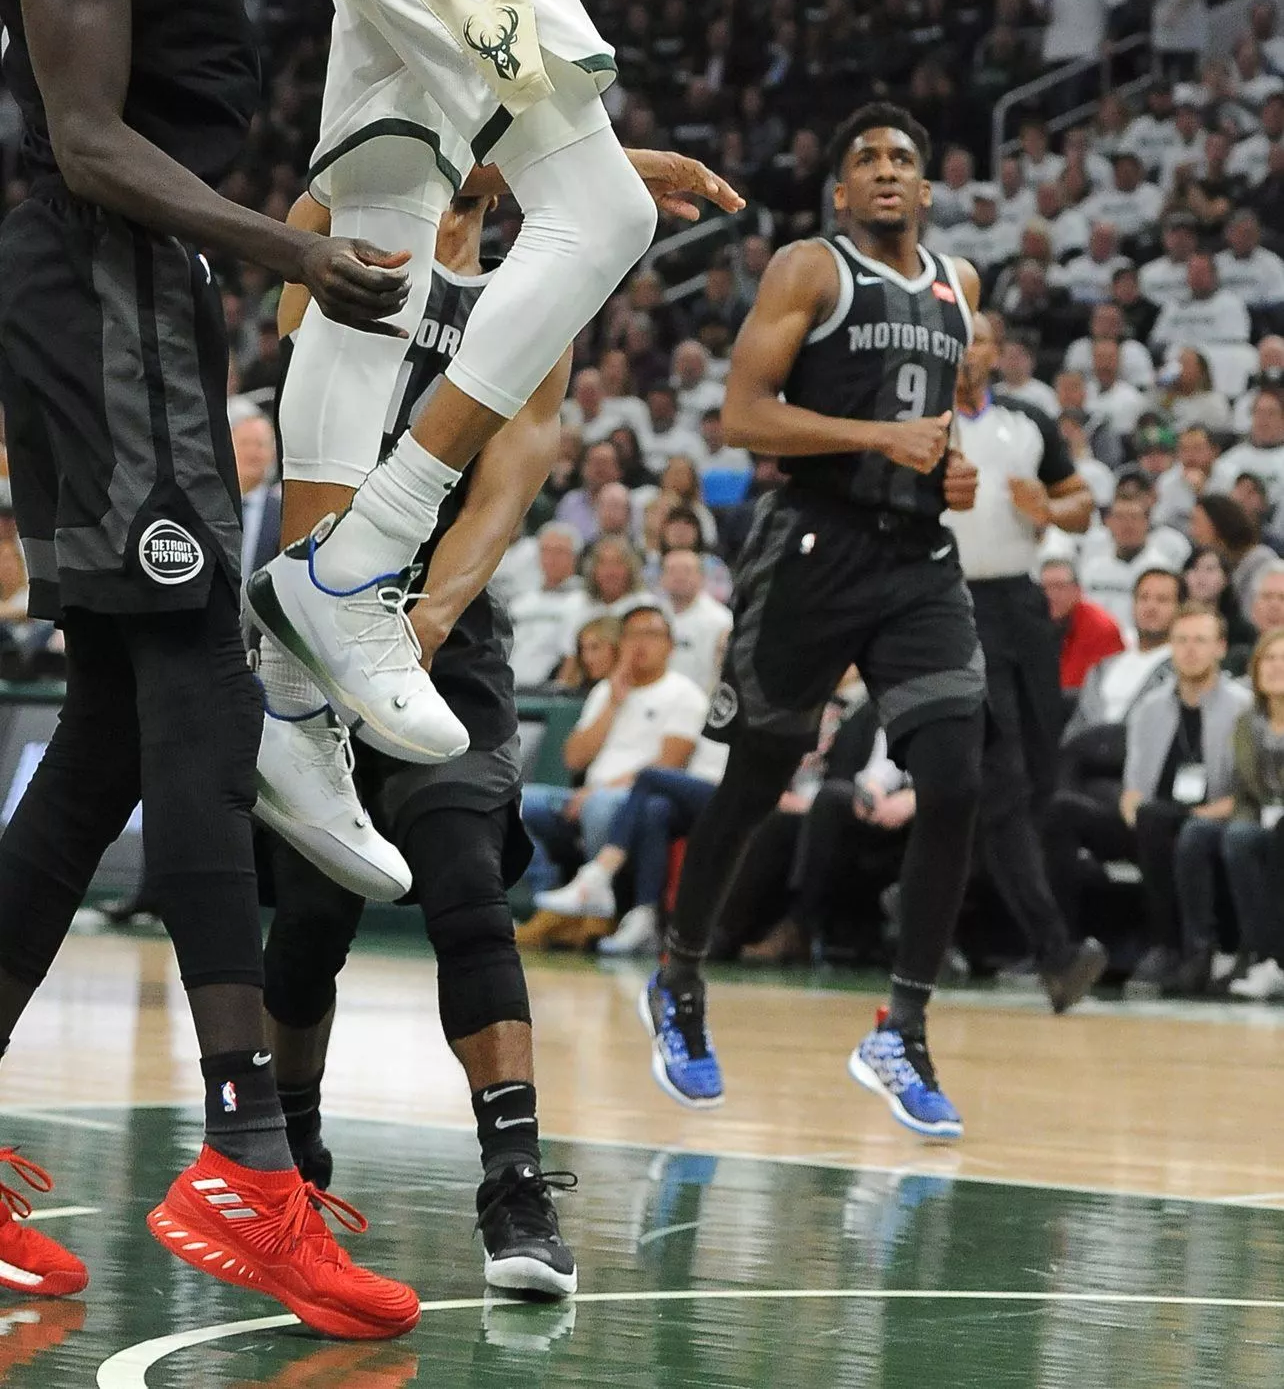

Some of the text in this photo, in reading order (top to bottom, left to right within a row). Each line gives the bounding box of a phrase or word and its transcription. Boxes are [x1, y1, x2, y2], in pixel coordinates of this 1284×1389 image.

[848, 322, 929, 353] MOTOR
[896, 362, 928, 421] 9
[151, 539, 191, 553] DETROIT
[151, 551, 194, 564] PISTONS
